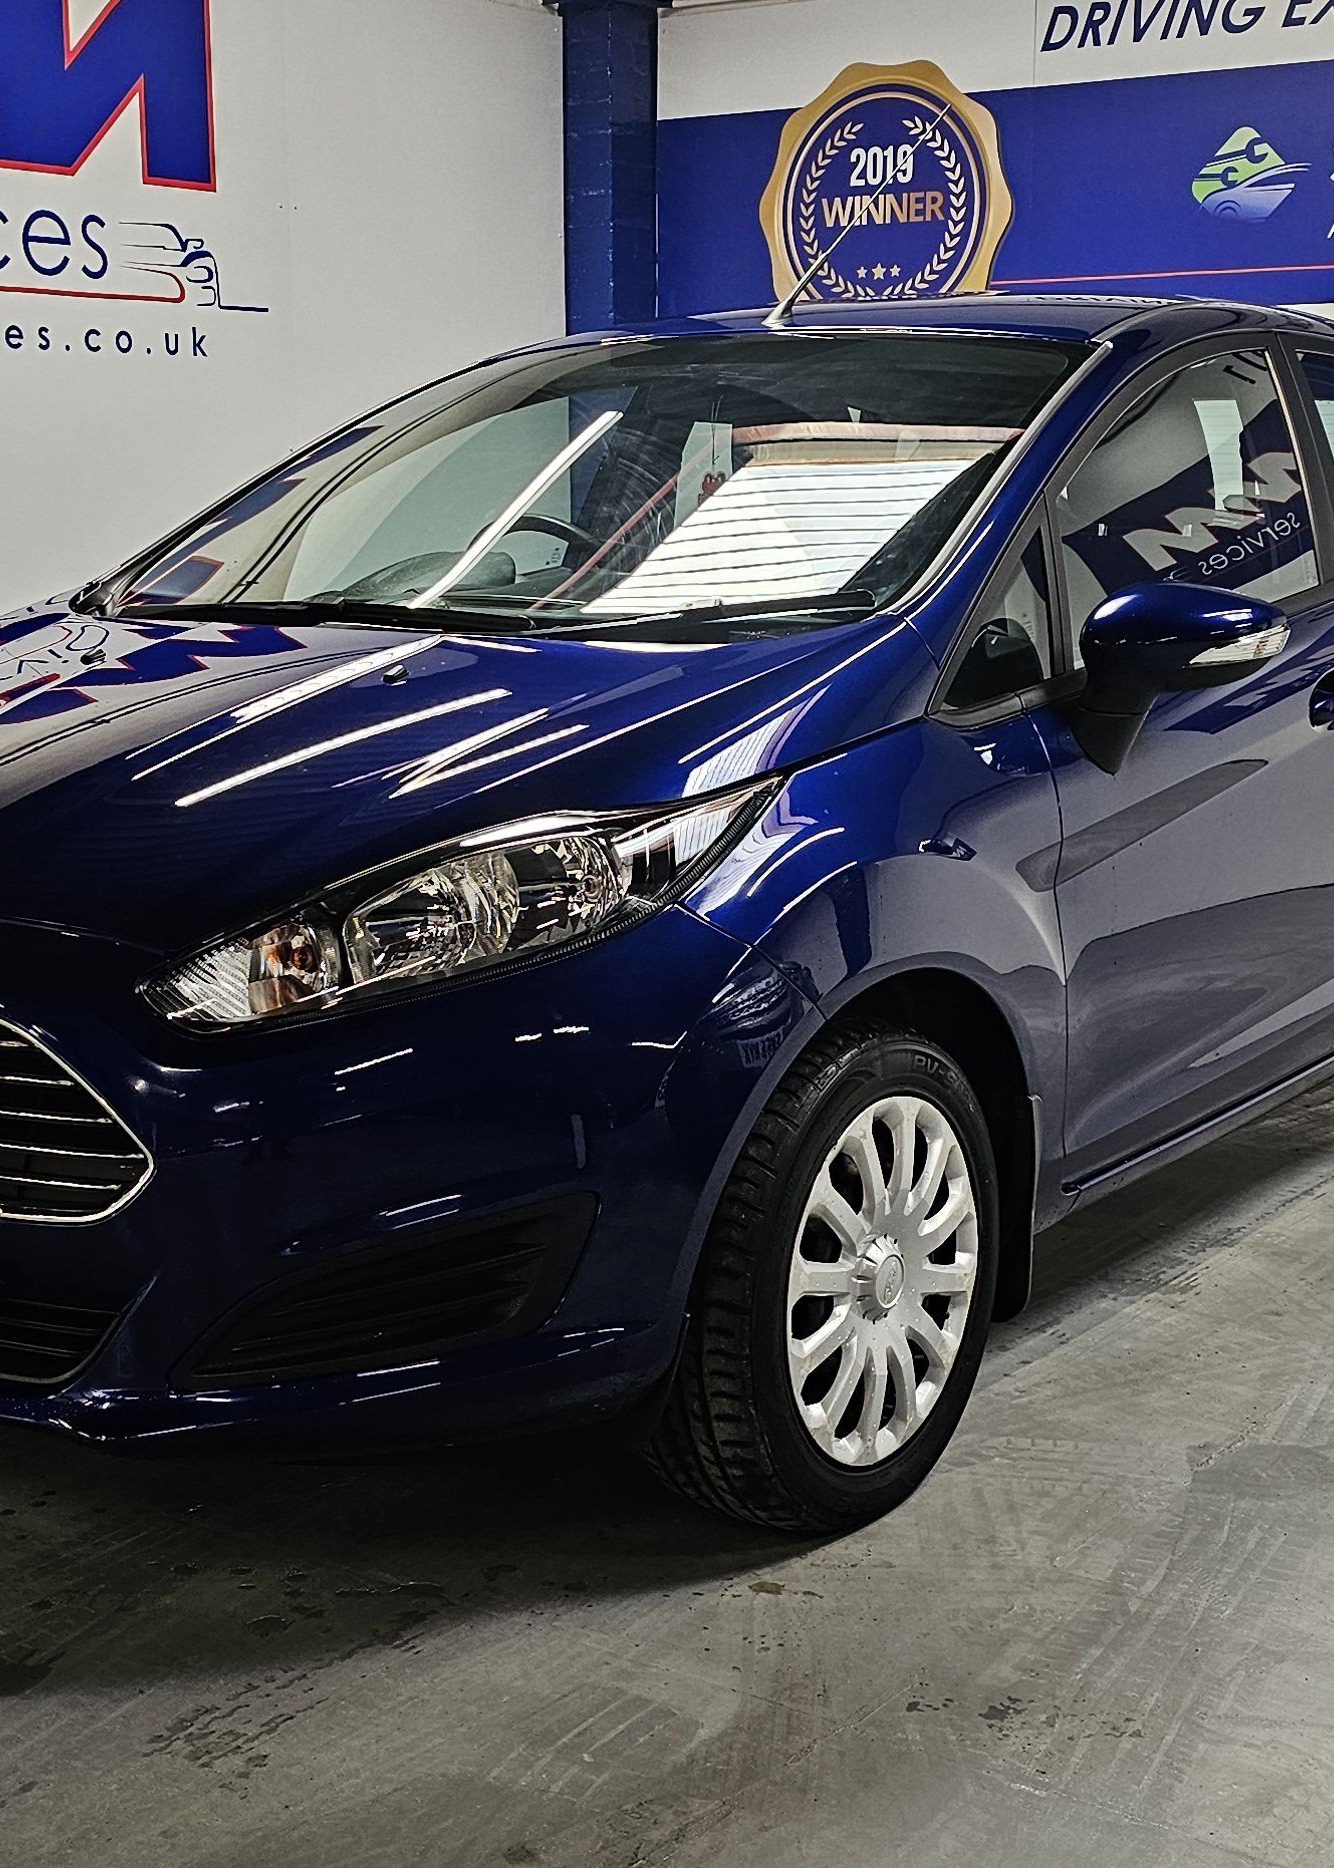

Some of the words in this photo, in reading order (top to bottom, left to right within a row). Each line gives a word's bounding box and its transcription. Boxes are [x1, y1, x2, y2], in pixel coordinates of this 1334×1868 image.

[1040, 0, 1266, 52] DRIVING
[849, 144, 914, 187] 2019
[822, 191, 945, 228] WINNER
